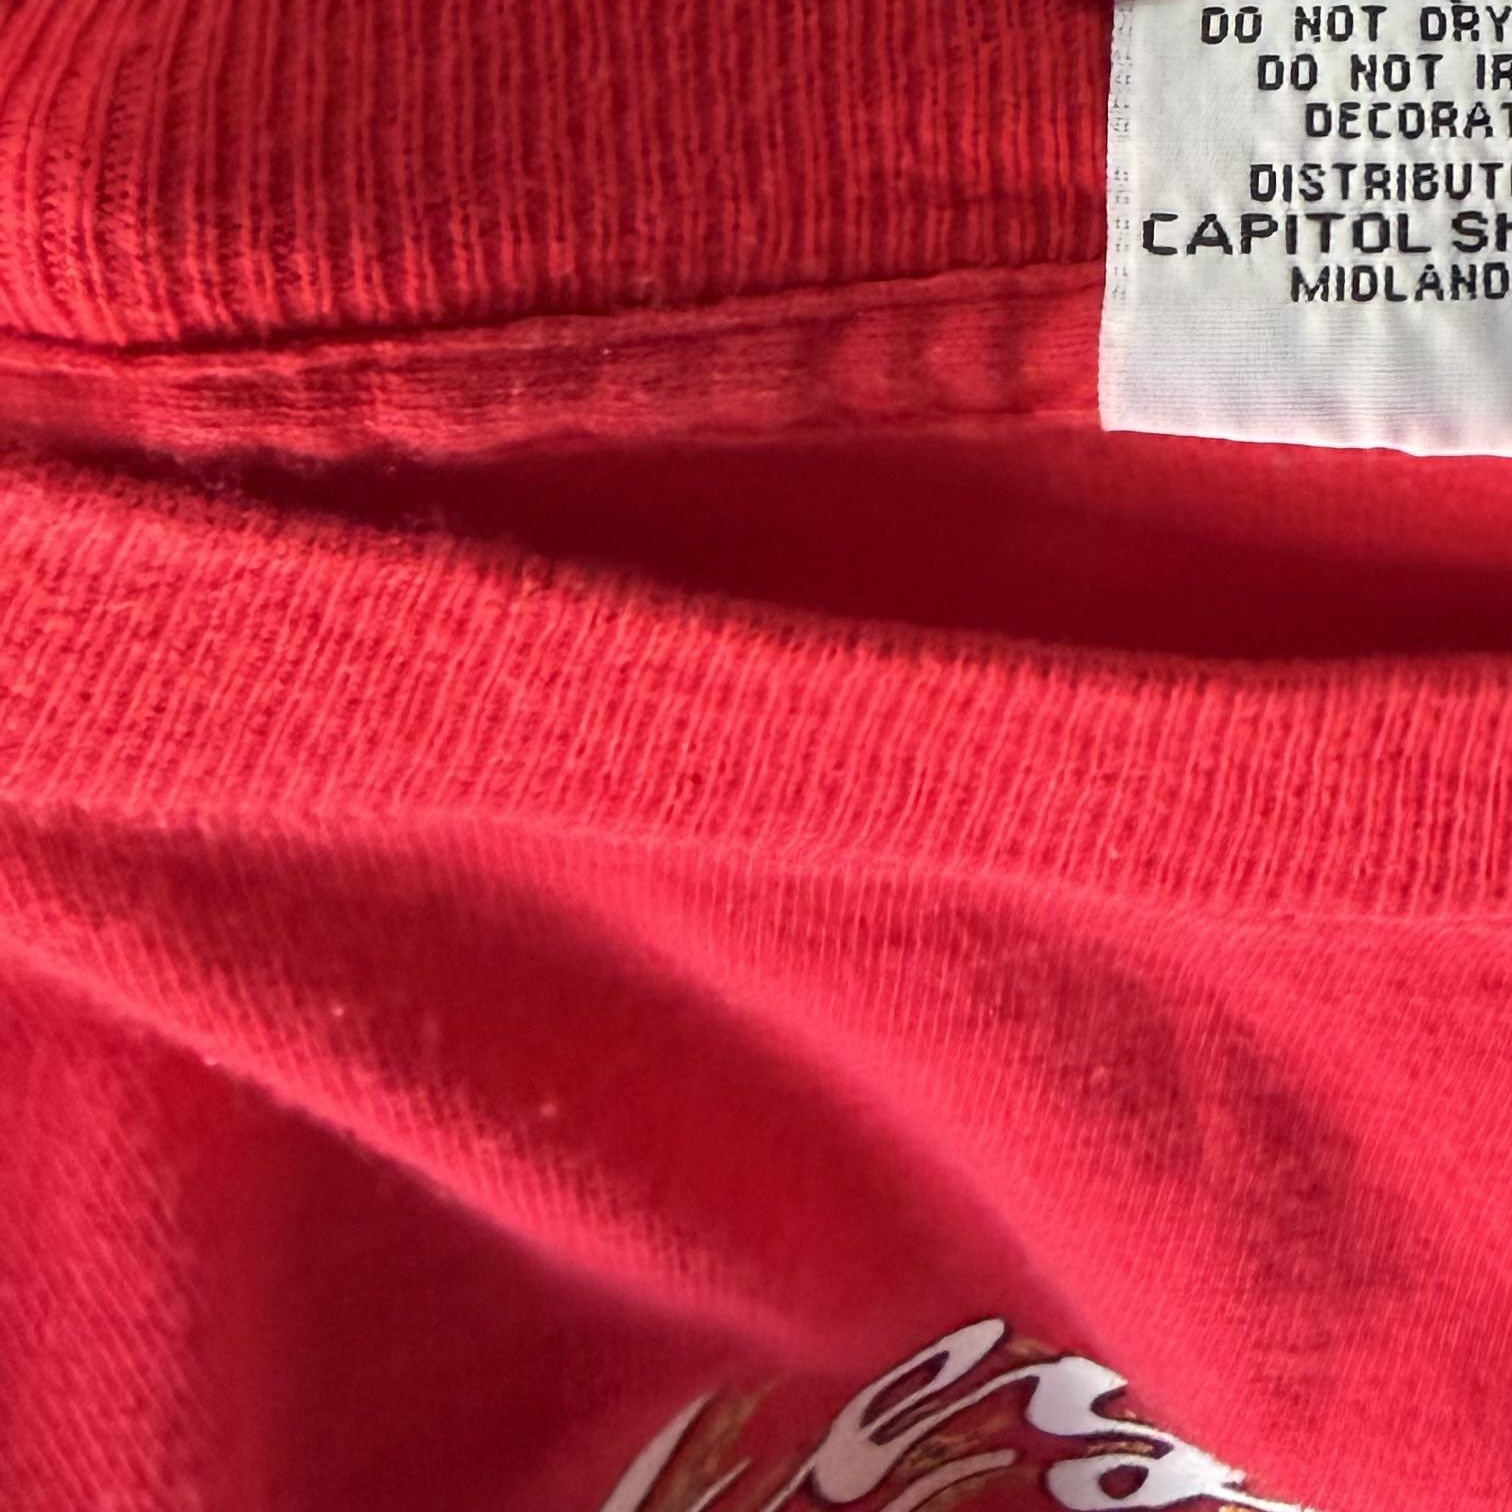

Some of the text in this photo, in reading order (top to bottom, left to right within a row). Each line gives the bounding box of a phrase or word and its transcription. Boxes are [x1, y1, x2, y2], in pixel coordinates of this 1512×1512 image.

[1200, 5, 1262, 45] DO
[1294, 4, 1388, 43] NOT
[1419, 4, 1512, 43] DRY
[1257, 53, 1318, 92] DO
[1350, 53, 1444, 92] NOT
[1142, 211, 1432, 256] CAPITOL
